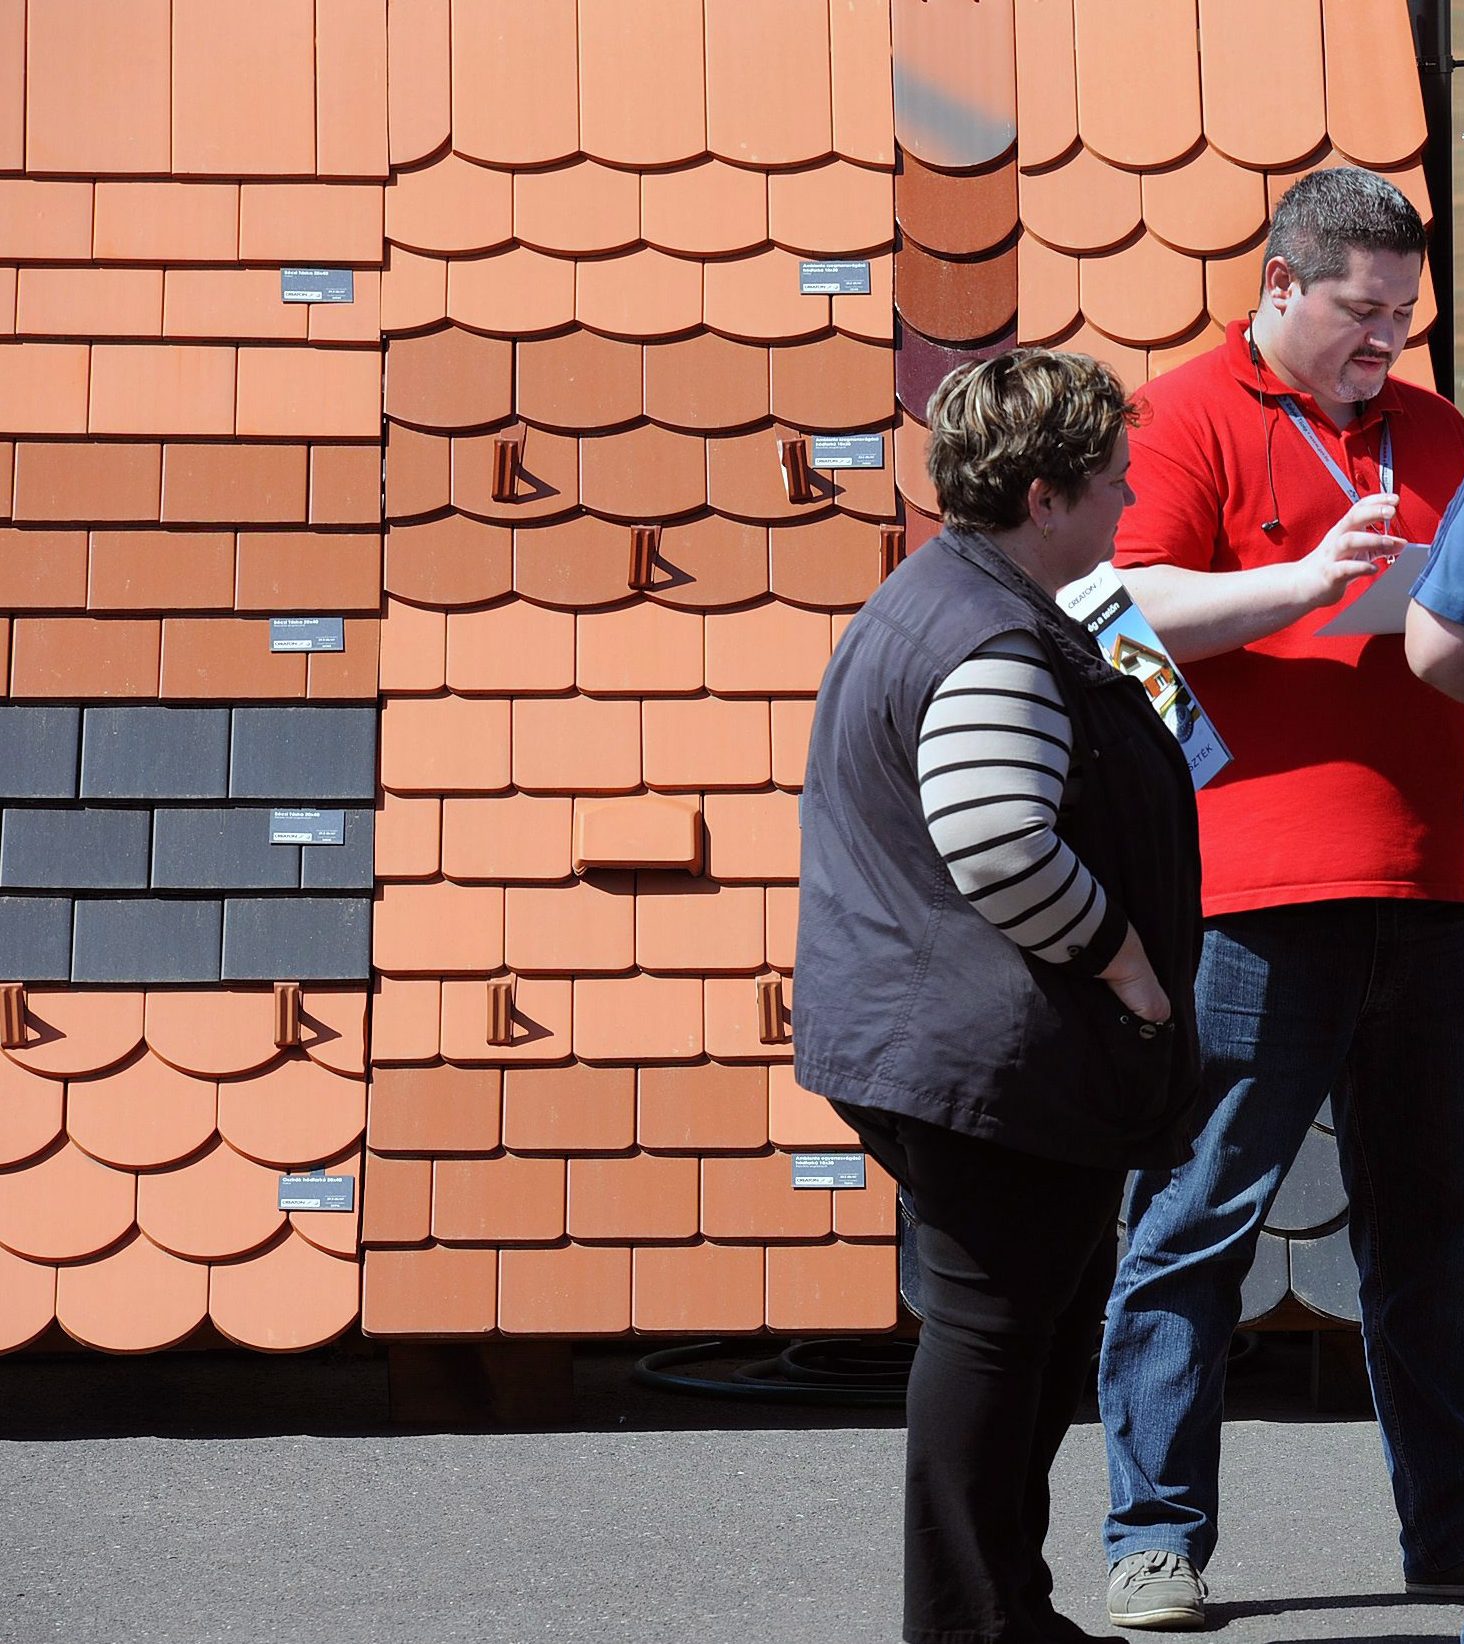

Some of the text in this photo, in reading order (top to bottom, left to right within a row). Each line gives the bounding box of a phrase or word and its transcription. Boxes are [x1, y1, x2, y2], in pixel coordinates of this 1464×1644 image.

[1068, 583, 1097, 609] CREATON
[1096, 616, 1105, 625] a
[1102, 602, 1120, 620] tetőn
